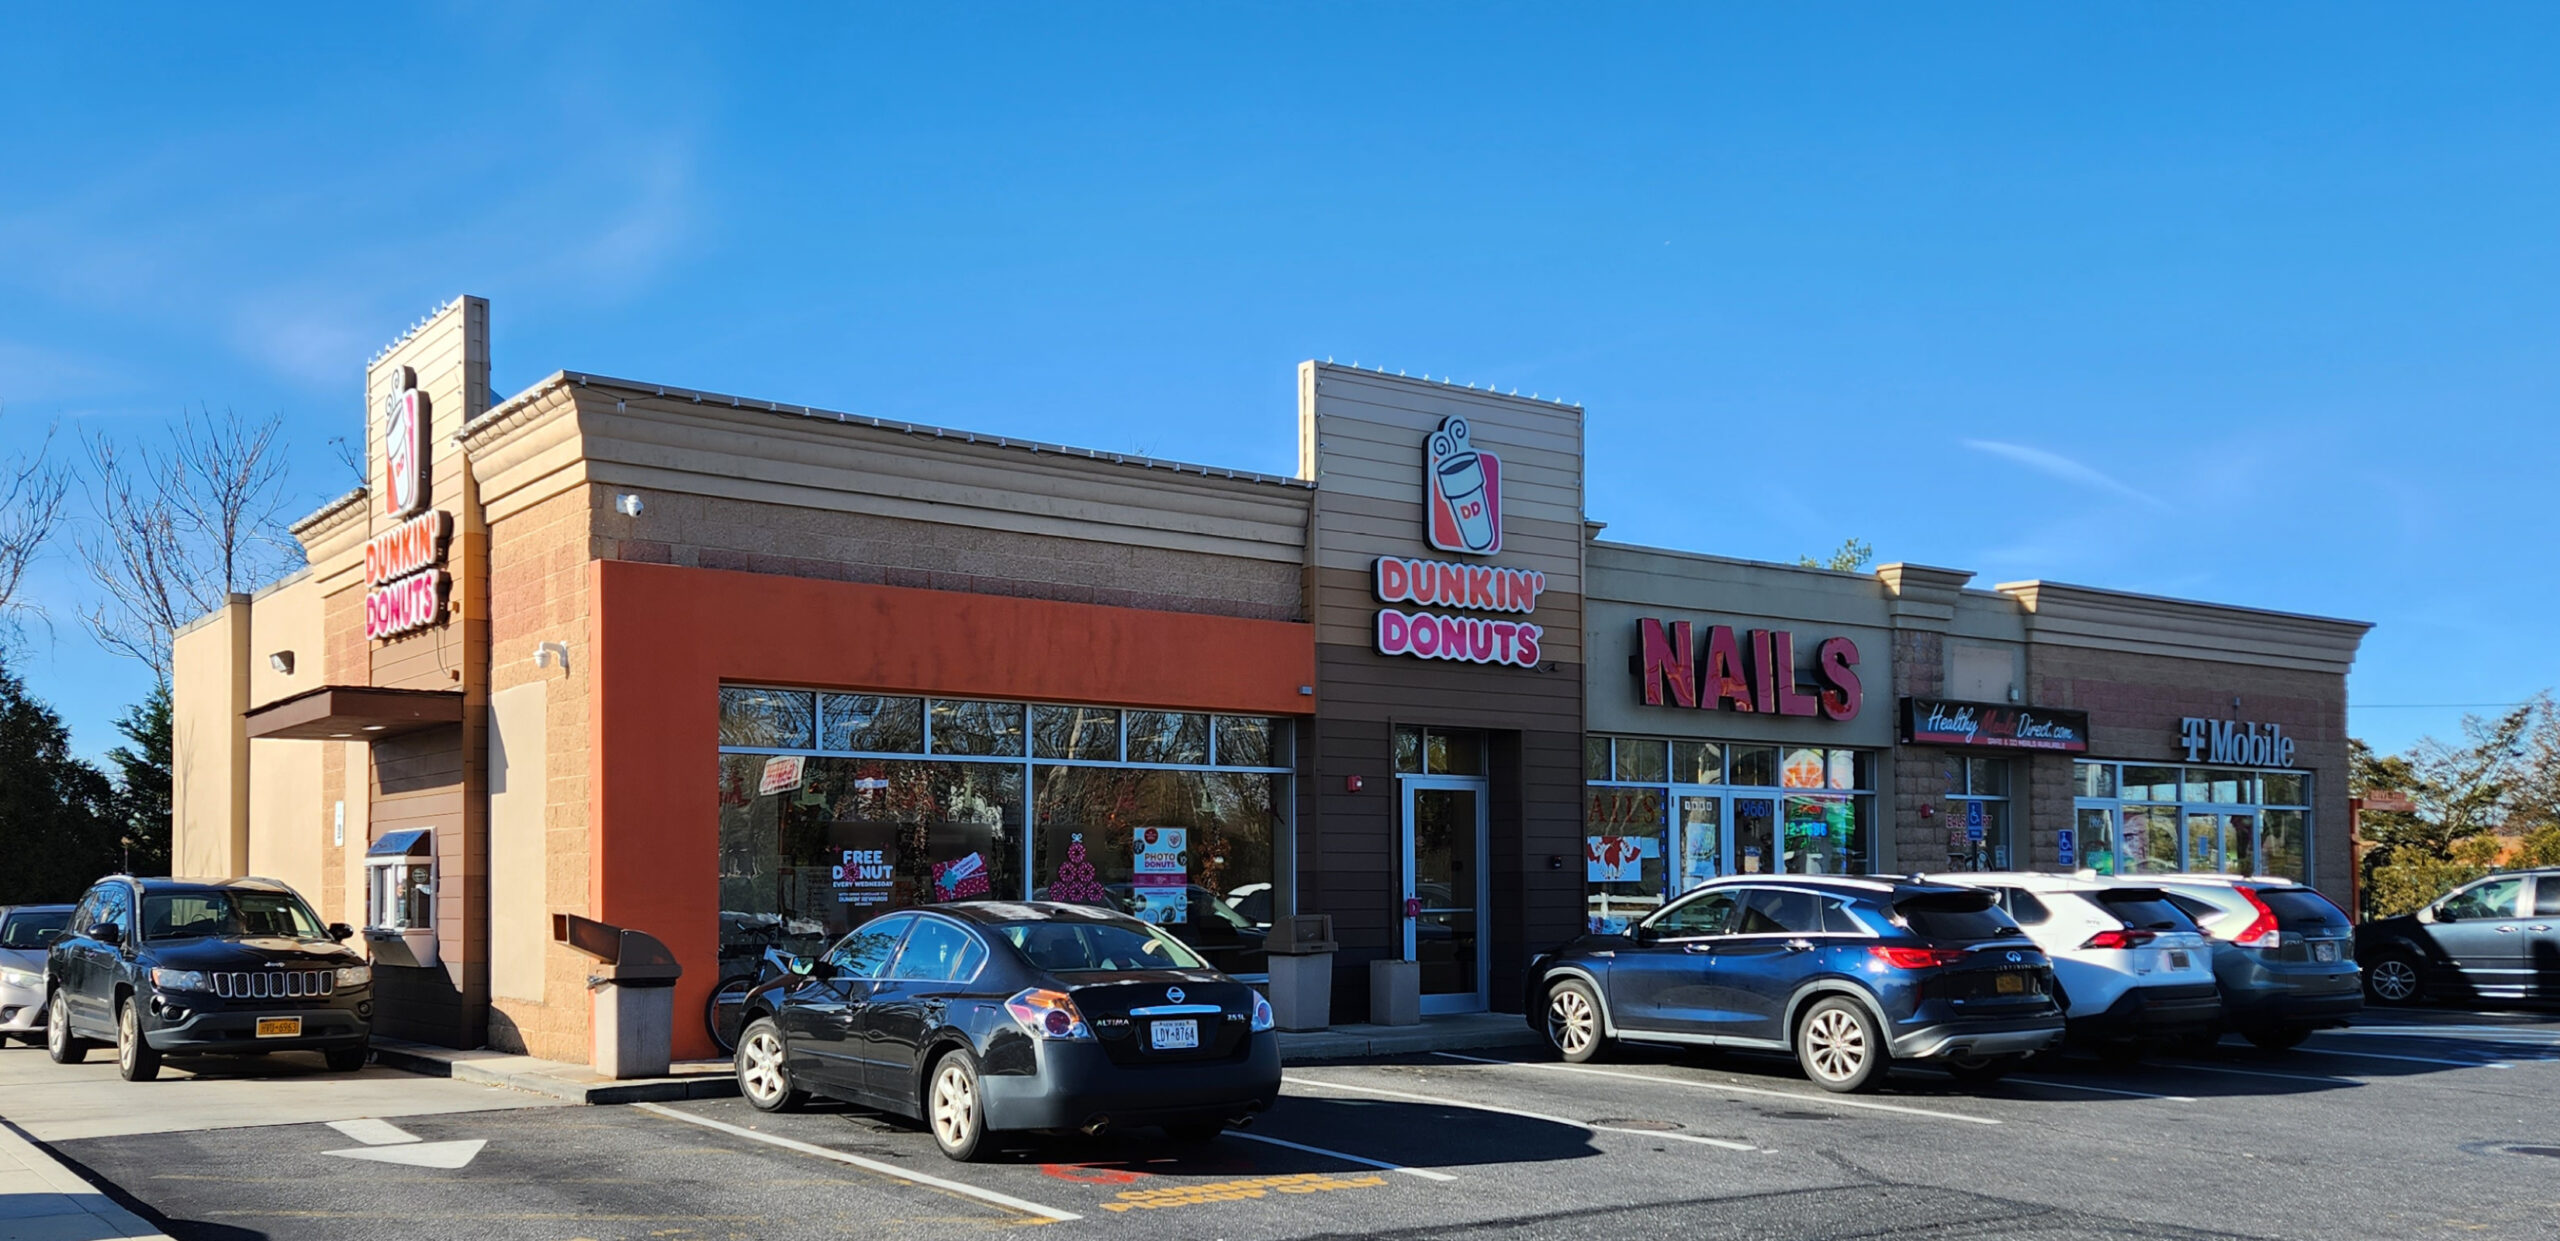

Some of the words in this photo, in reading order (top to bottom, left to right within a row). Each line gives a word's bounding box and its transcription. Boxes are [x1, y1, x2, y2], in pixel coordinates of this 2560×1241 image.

[1461, 501, 1481, 520] DD
[366, 515, 436, 585] DUNKIN'
[1381, 559, 1544, 611] DUNKIN'
[366, 575, 433, 639] DONUTS
[1382, 612, 1539, 666] DONUTS
[1638, 617, 1863, 721] NAILS
[1927, 702, 1979, 744] Healthy
[832, 864, 894, 881] DONUT
[843, 850, 883, 865] FREE
[1144, 852, 1176, 861] PHOTO
[1096, 1018, 1130, 1027] ALTIMA
